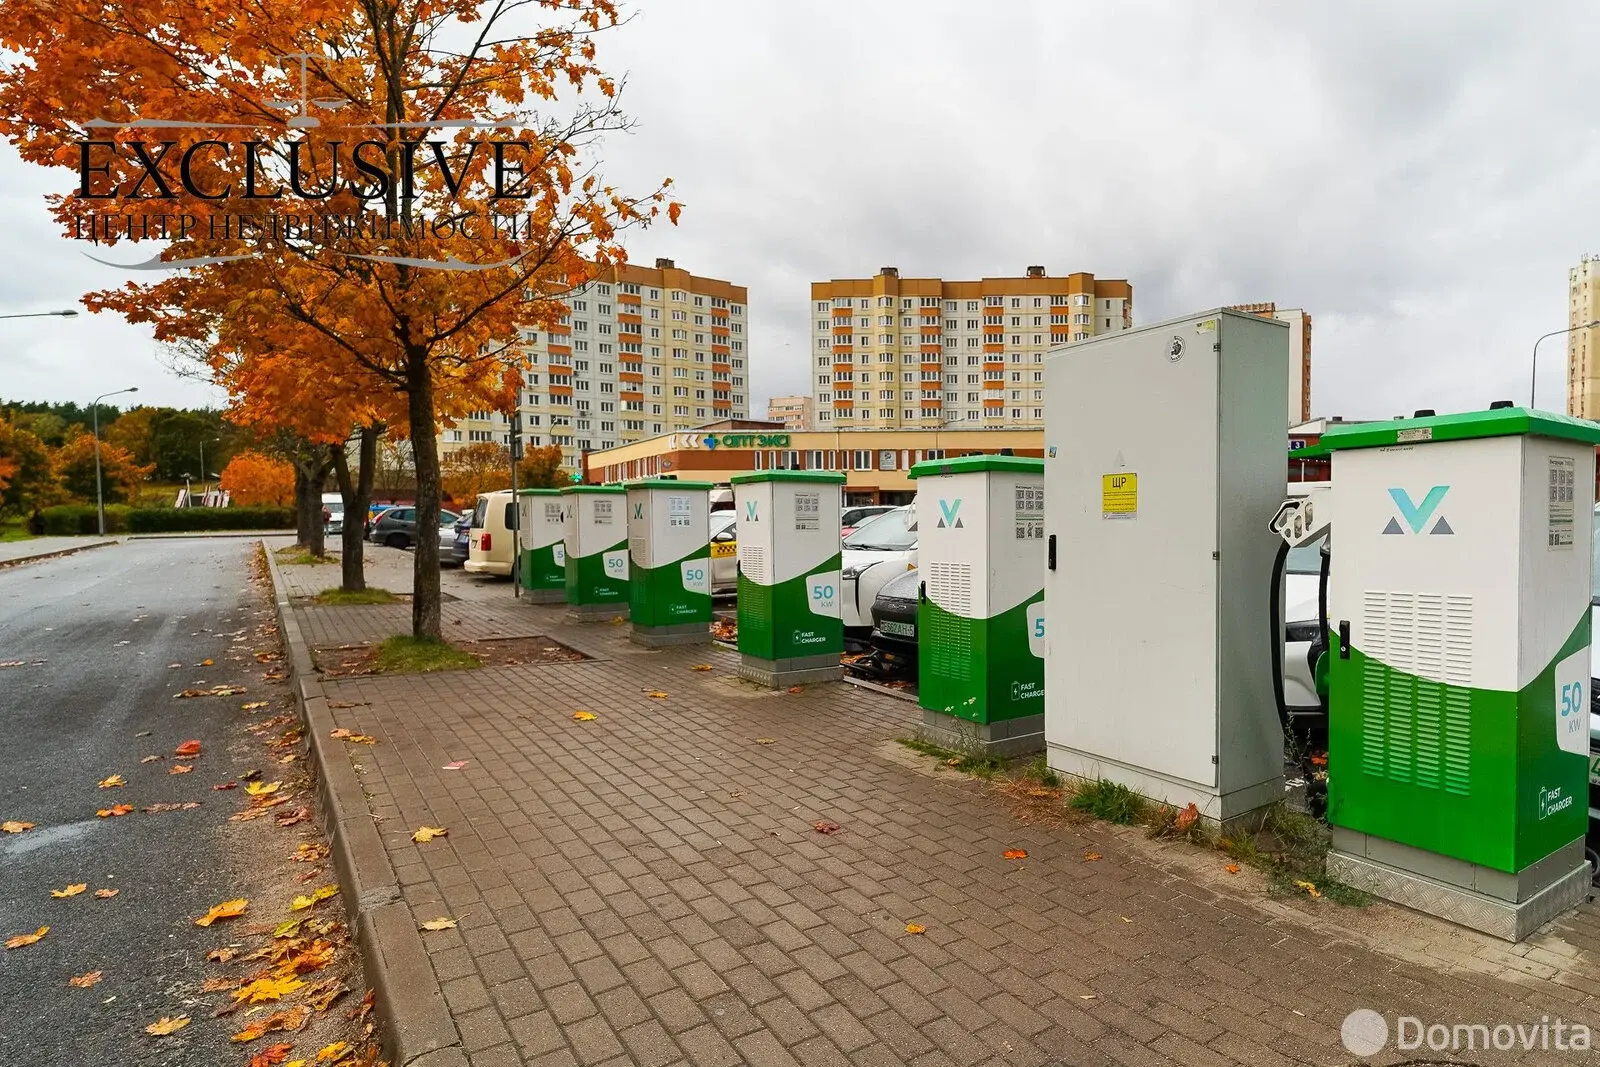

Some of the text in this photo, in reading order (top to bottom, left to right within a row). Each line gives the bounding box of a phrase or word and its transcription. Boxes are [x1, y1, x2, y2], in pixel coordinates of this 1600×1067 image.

[1112, 477, 1127, 489] ЩР
[608, 558, 624, 568] 50
[686, 569, 704, 580] 50
[813, 585, 834, 600] 50
[1034, 618, 1045, 638] 5
[801, 636, 826, 644] CHARGER
[1020, 682, 1035, 691] FAST
[1020, 689, 1045, 699] CHARGE
[1561, 681, 1582, 717] 50
[1568, 717, 1582, 733] KW
[1547, 786, 1561, 802] FAST
[1547, 796, 1573, 816] CHARGER
